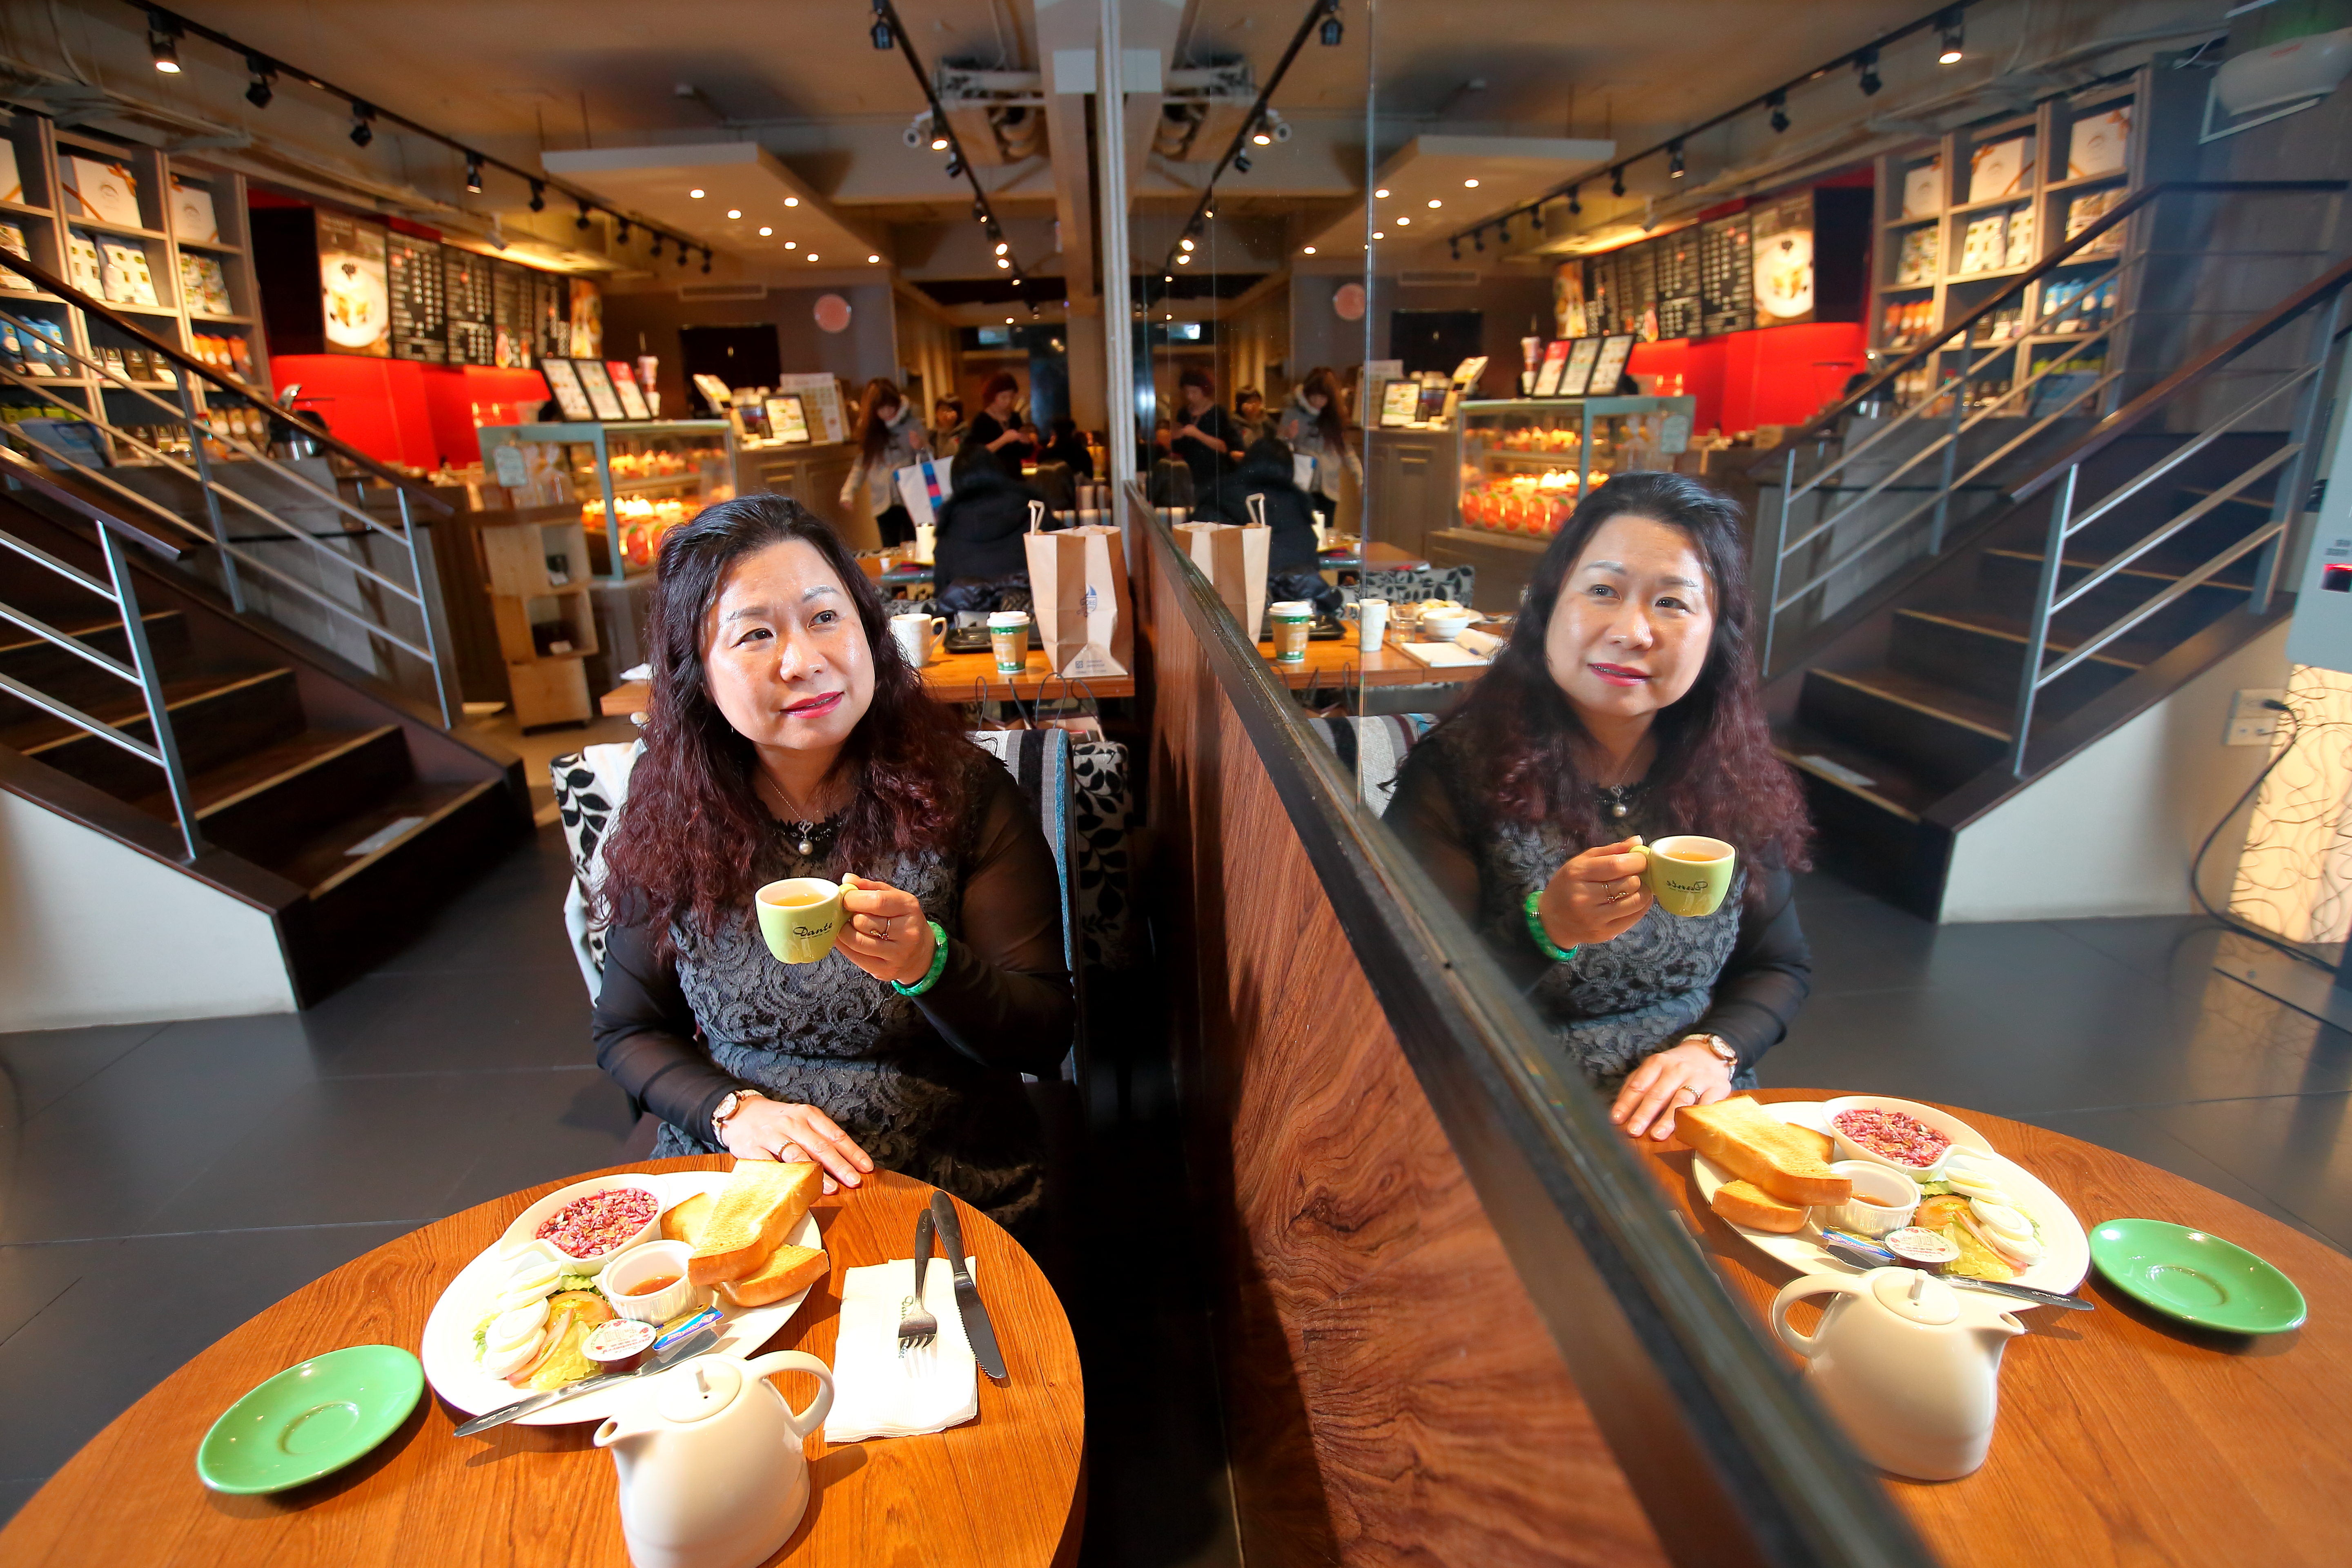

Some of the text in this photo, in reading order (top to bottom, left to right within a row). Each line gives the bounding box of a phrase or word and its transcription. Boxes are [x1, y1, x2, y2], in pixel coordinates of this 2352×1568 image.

[793, 922, 833, 937] Dante
[668, 1321, 701, 1340] Anchor
[602, 1337, 650, 1354] Strawberry
